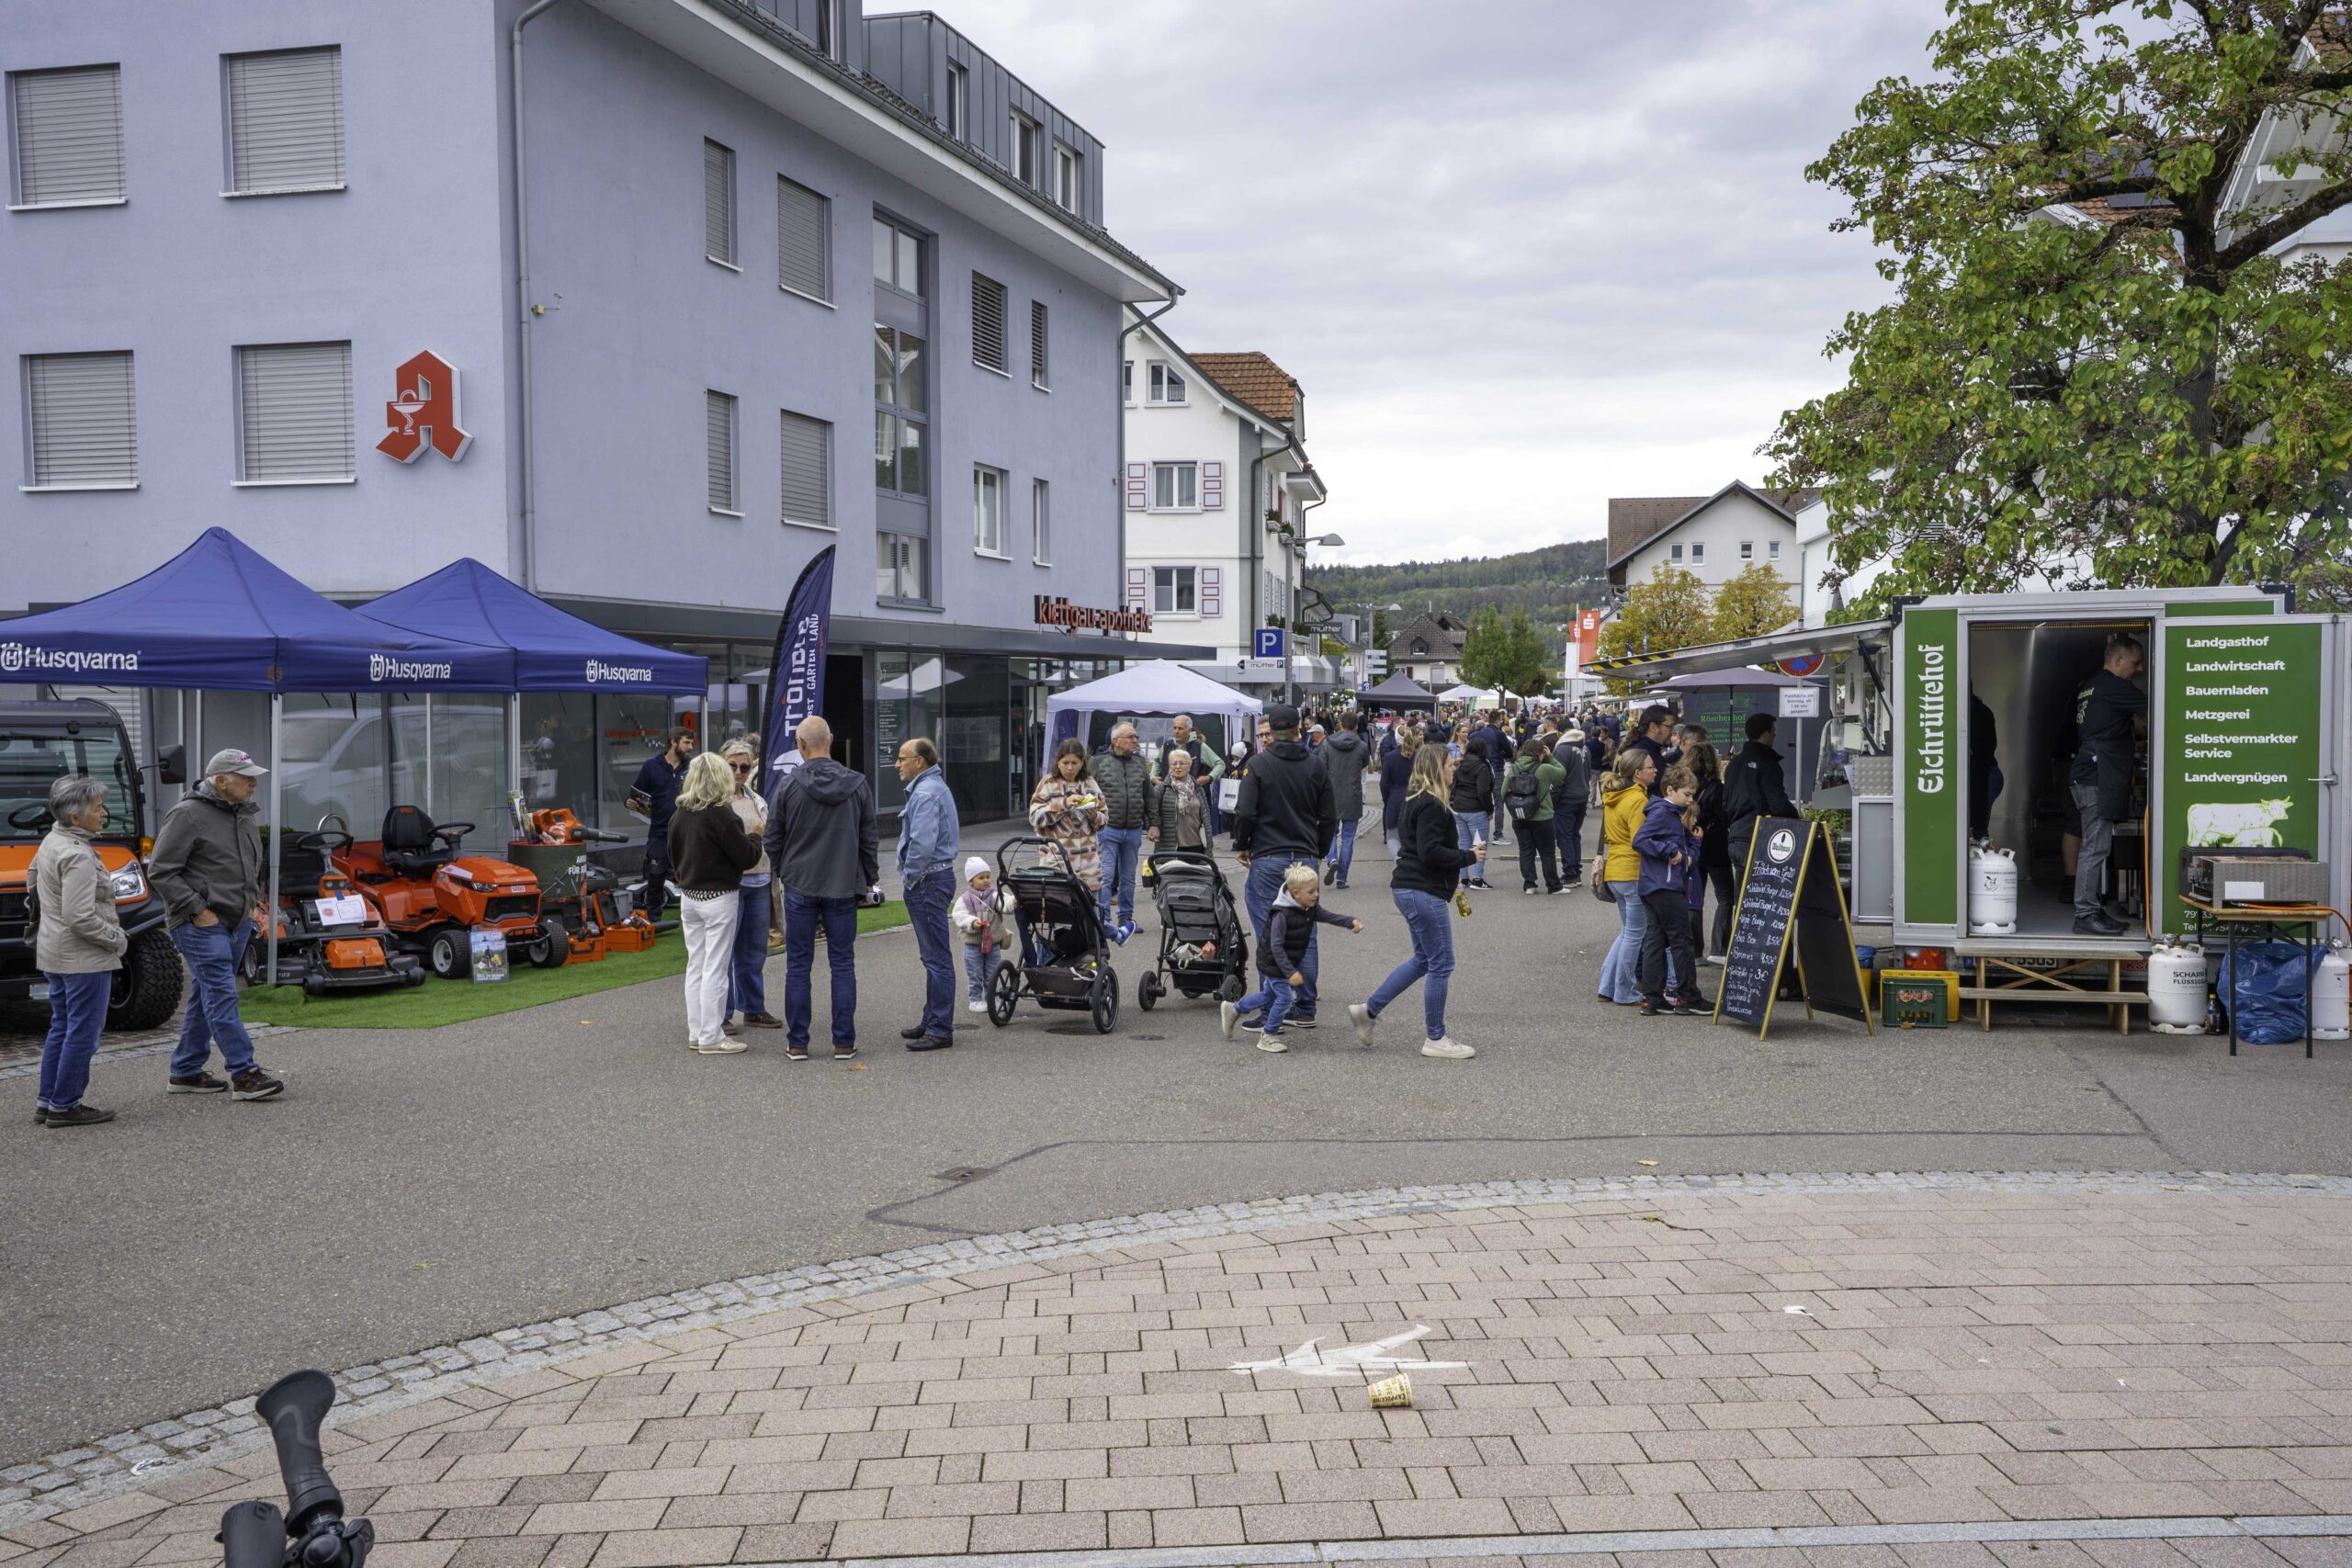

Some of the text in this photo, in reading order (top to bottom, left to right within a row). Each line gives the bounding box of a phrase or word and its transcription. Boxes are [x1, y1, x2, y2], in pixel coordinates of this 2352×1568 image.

[1035, 595, 1153, 637] klettgau-apotheke
[808, 614, 820, 642] LAND
[1261, 633, 1277, 654] P
[2186, 636, 2269, 649] Landgasthof
[25, 647, 139, 671] Husqvarna
[2186, 660, 2286, 671] Landwirtschaft
[385, 660, 451, 681] Husqvarna
[598, 663, 651, 682] Husqvarna
[806, 649, 817, 691] GARTEN
[2186, 685, 2269, 696] Bauernladen
[1917, 644, 1944, 794] Eichrüttehof
[2185, 708, 2250, 722] Metzgerei
[2185, 733, 2299, 744] Selbstvermarkter
[2185, 748, 2233, 759] Service
[2185, 772, 2288, 784] Landvergnügen
[568, 865, 581, 874] FÜR
[2184, 910, 2213, 919] 7933
